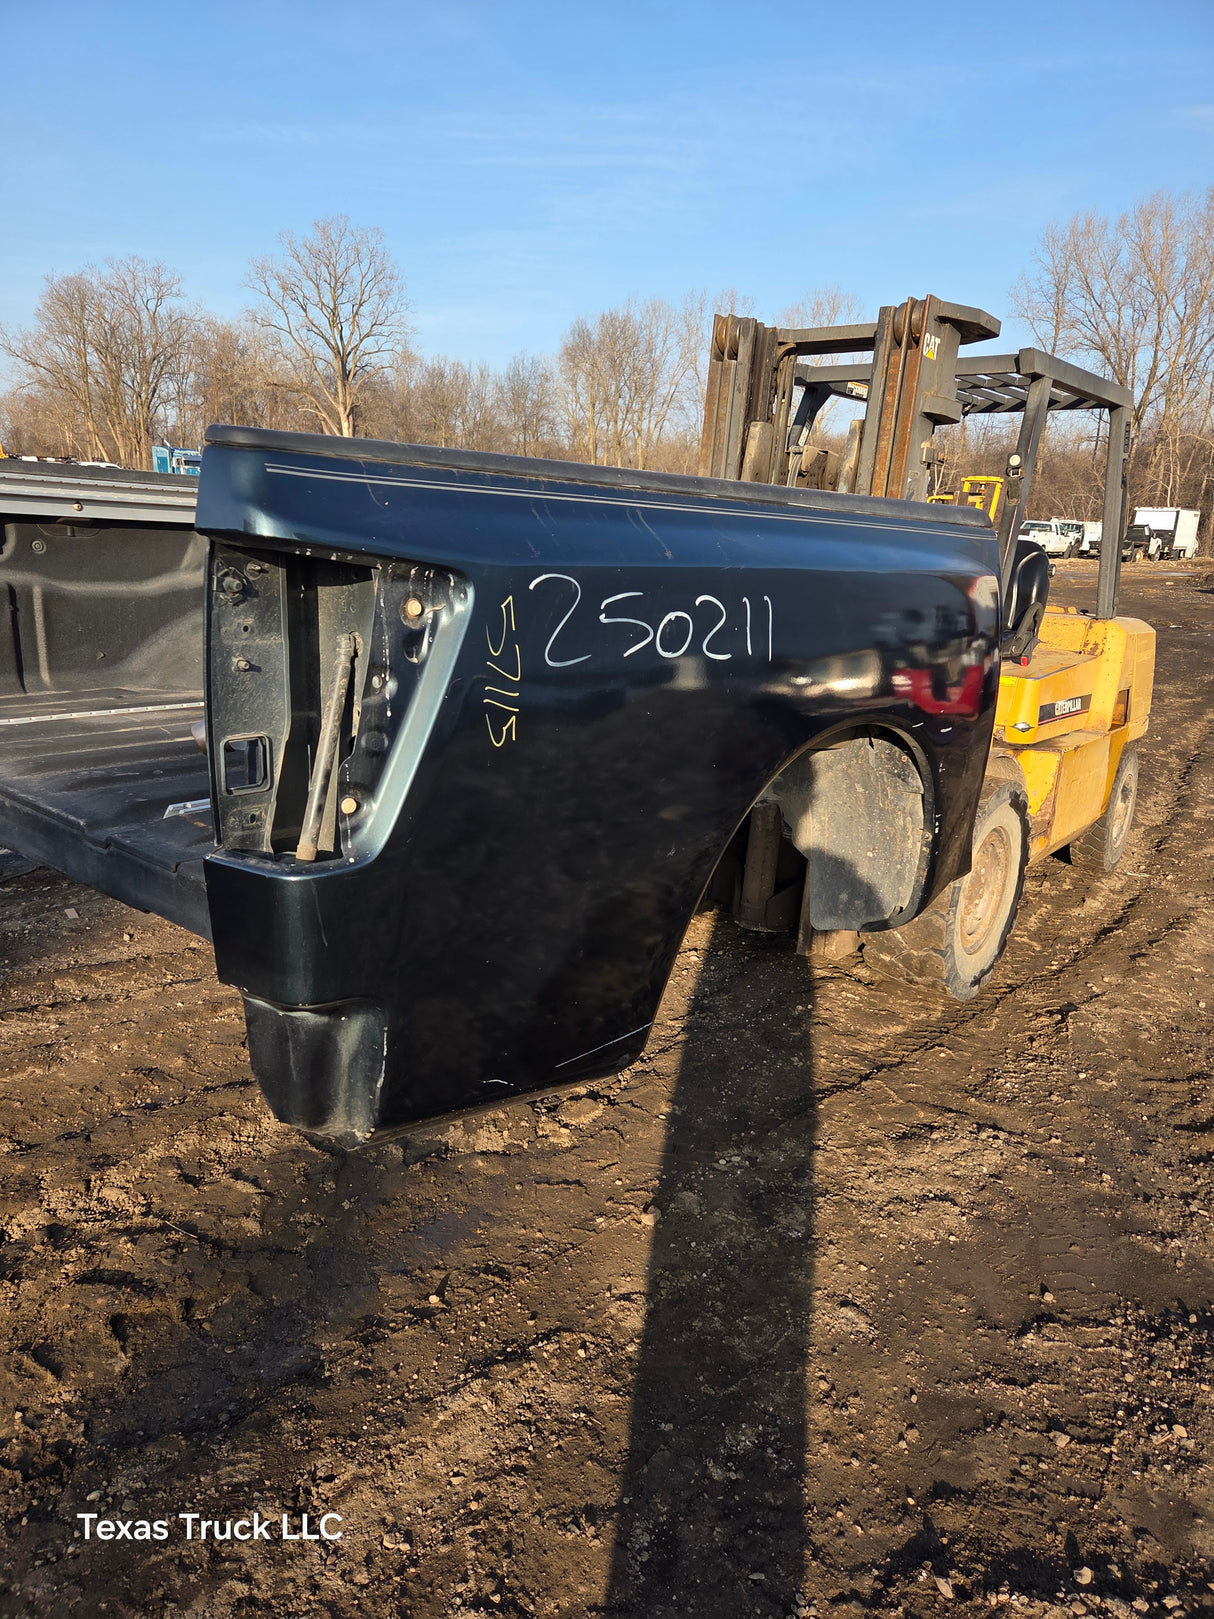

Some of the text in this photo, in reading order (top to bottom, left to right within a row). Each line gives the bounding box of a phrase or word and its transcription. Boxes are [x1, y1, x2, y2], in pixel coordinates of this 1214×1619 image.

[923, 332, 941, 360] CAT
[528, 573, 772, 668] 250211
[483, 595, 521, 748] 57115
[1054, 697, 1082, 716] CATERPILLAR
